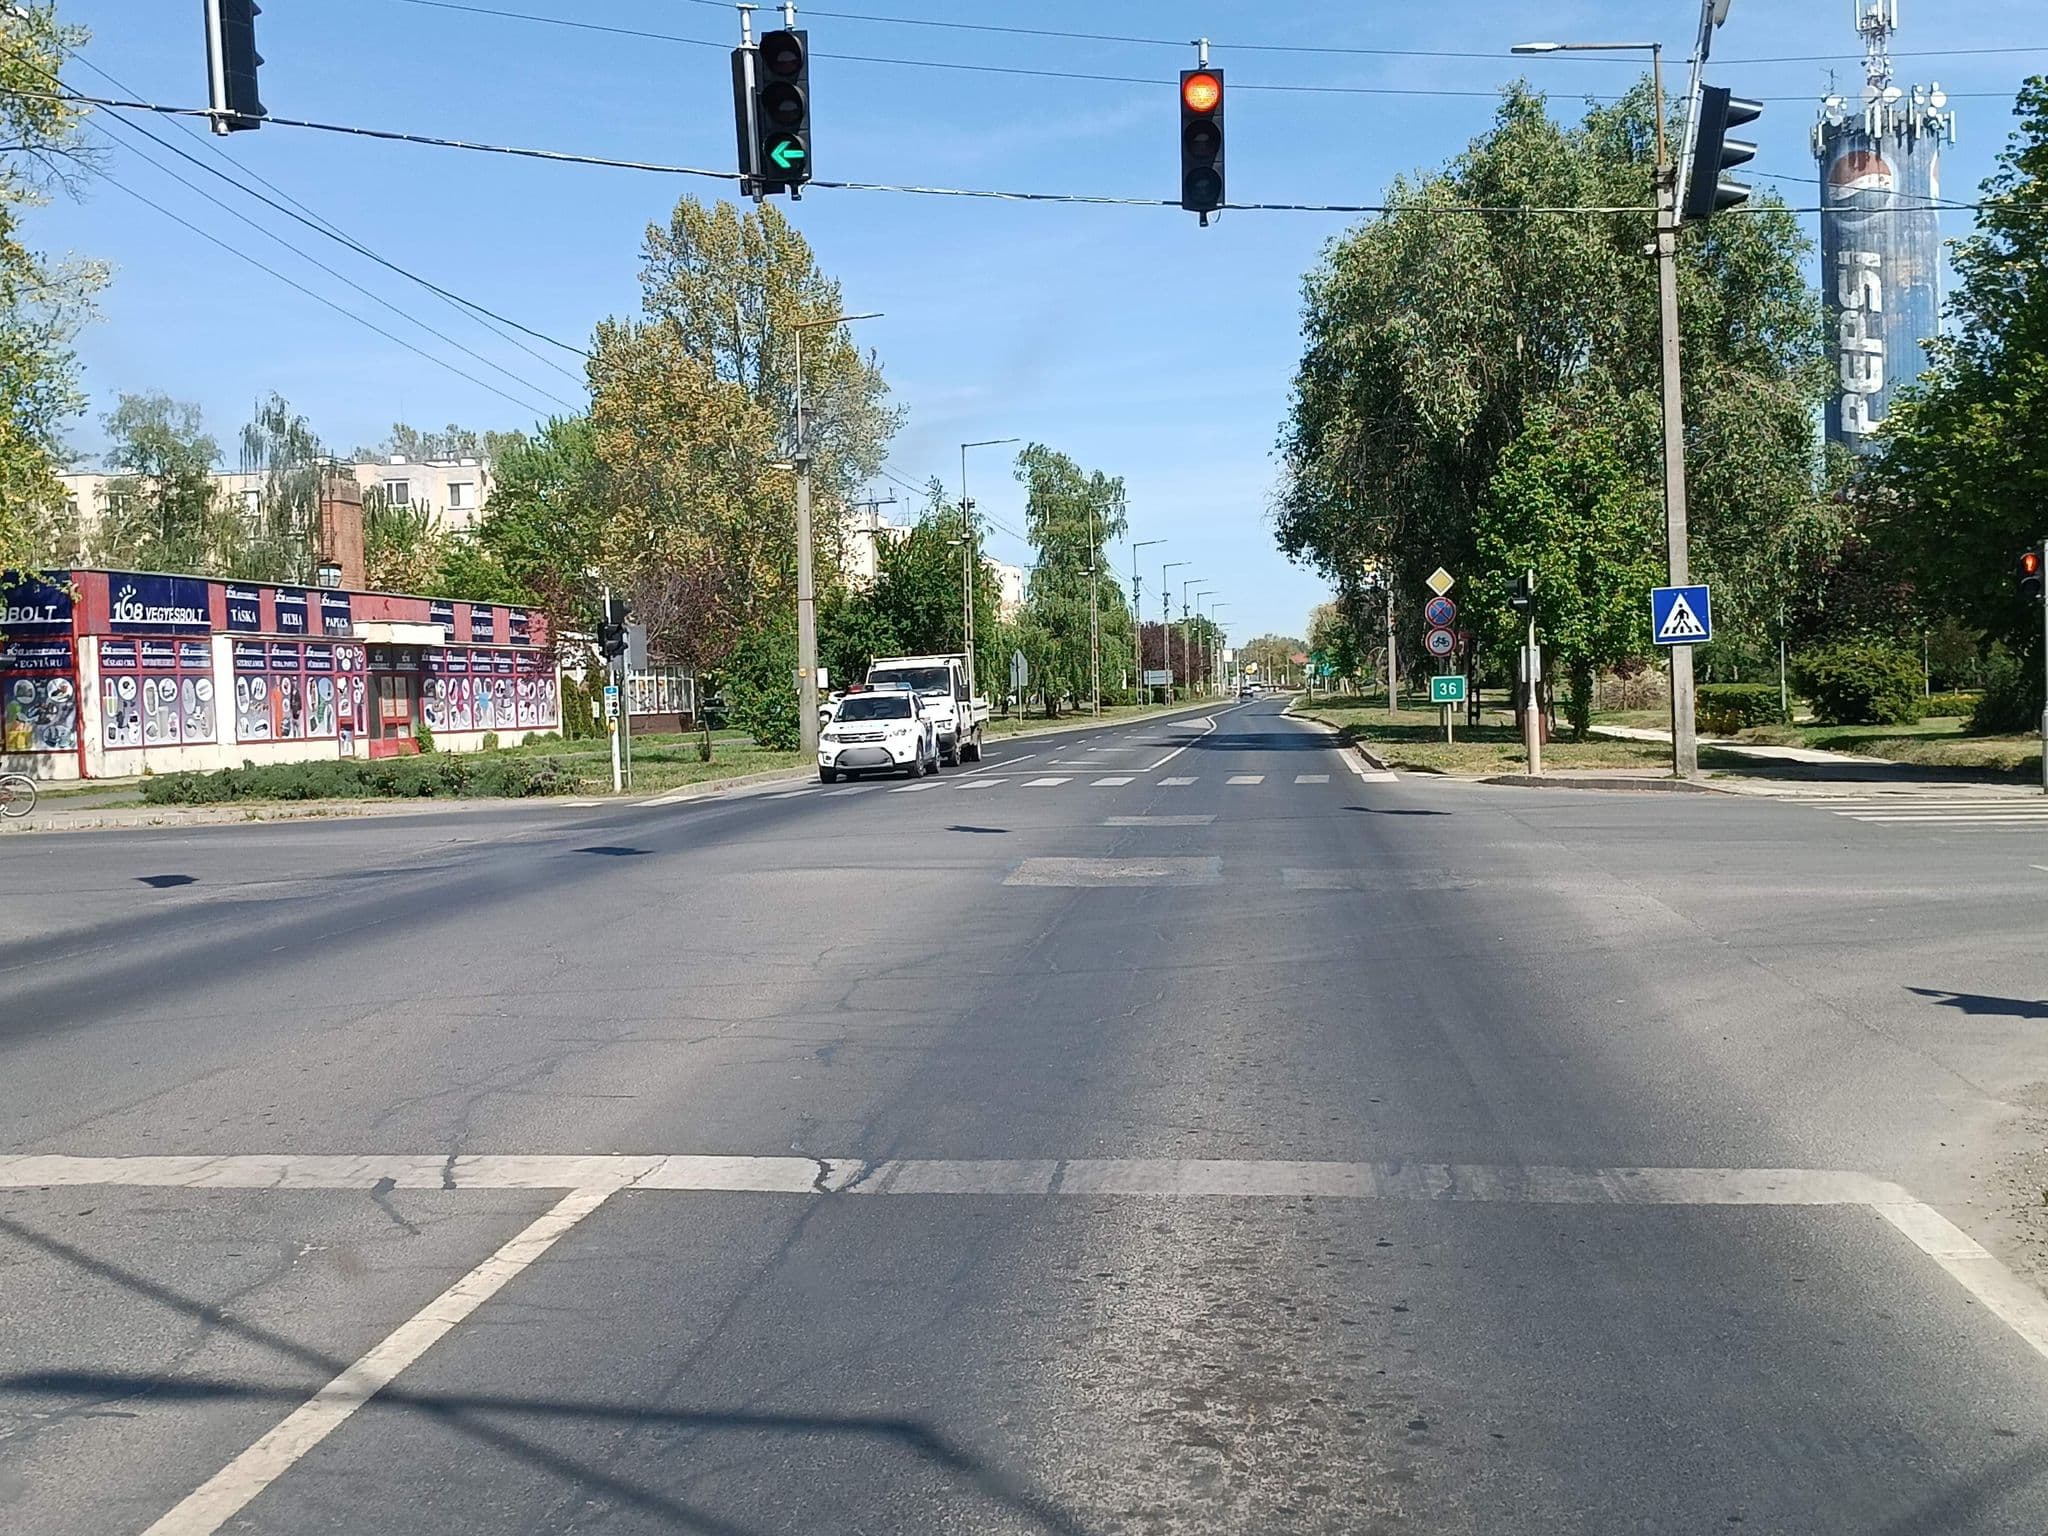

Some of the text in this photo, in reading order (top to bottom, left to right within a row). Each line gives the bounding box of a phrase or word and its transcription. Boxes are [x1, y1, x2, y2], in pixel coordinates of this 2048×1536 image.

[1838, 251, 1883, 434] PEPSI
[113, 593, 204, 622] 108 VEGYESBOLT
[231, 606, 257, 623] TÁSKA
[282, 613, 302, 625] RUHA
[1440, 682, 1457, 695] 36
